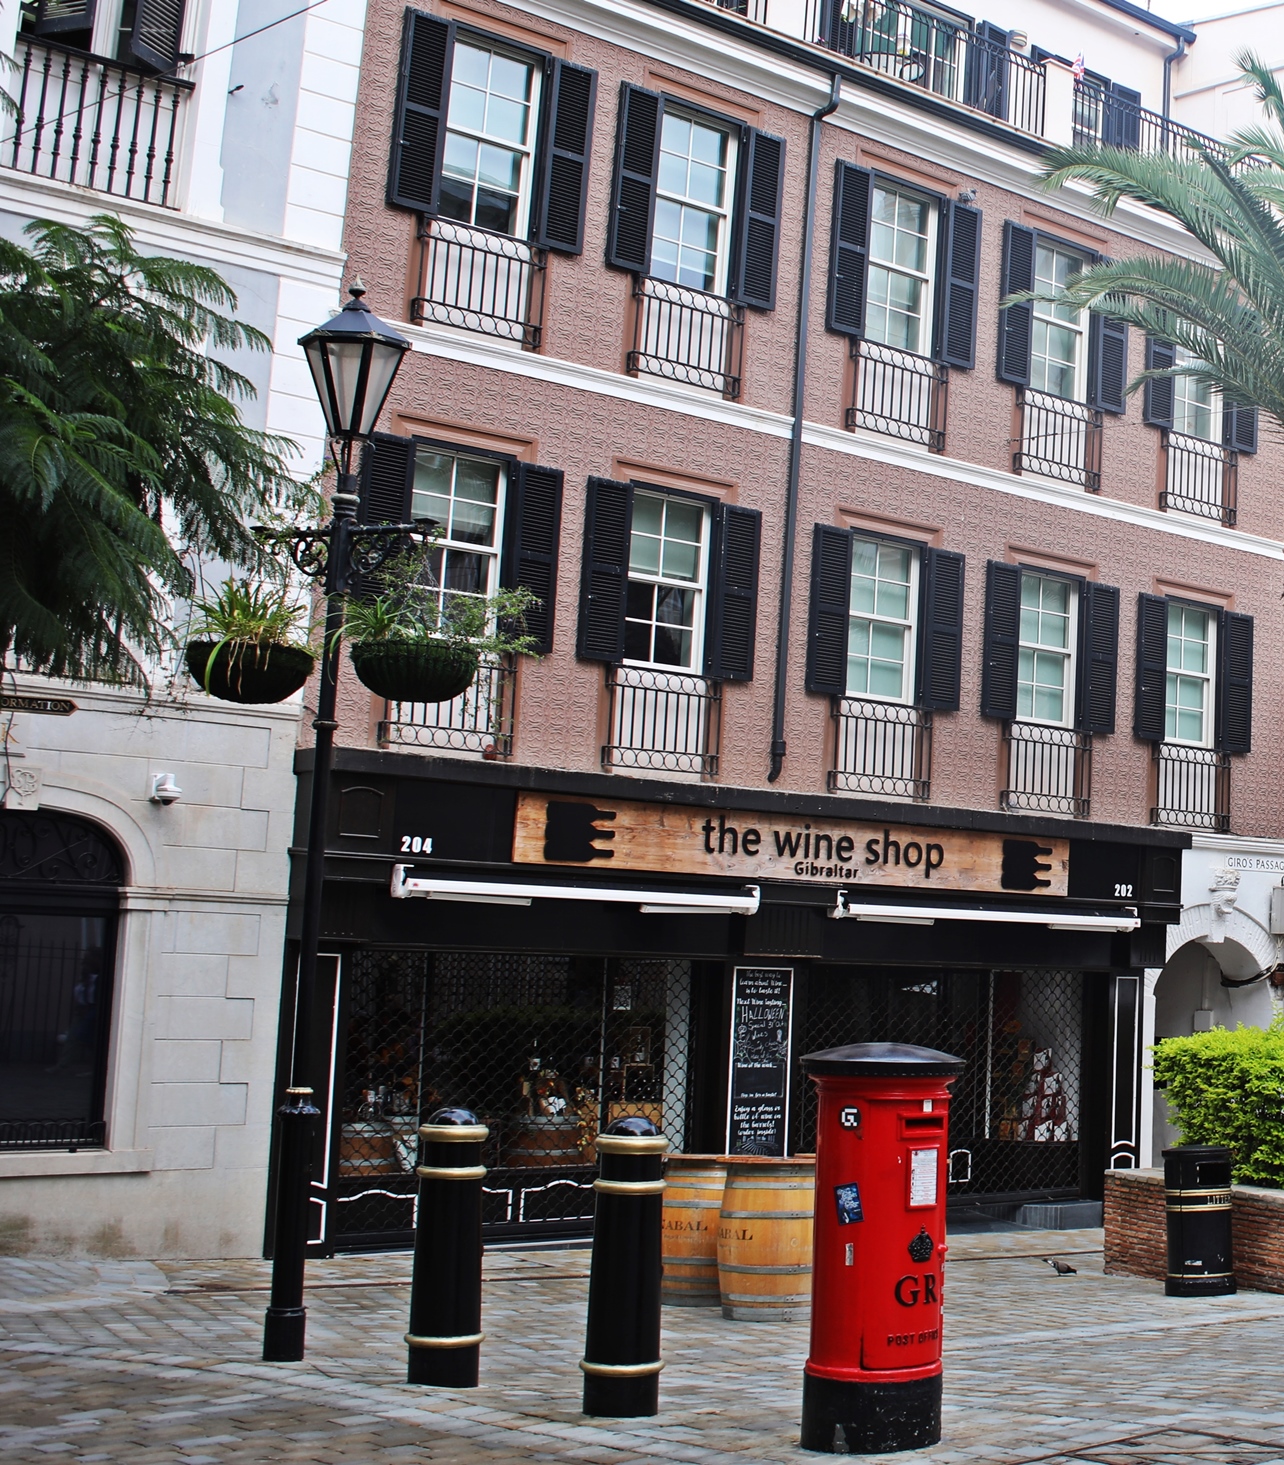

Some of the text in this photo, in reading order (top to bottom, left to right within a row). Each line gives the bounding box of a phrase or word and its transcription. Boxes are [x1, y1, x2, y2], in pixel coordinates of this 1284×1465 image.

[401, 835, 433, 854] 204
[702, 815, 944, 879] the wine shop
[794, 861, 859, 879] Gibraltar
[1227, 857, 1253, 869] GIRO'S
[1114, 883, 1133, 897] 202
[741, 1005, 785, 1023] HALLOWEEN
[894, 1273, 938, 1308] GR
[887, 1333, 915, 1346] POST
